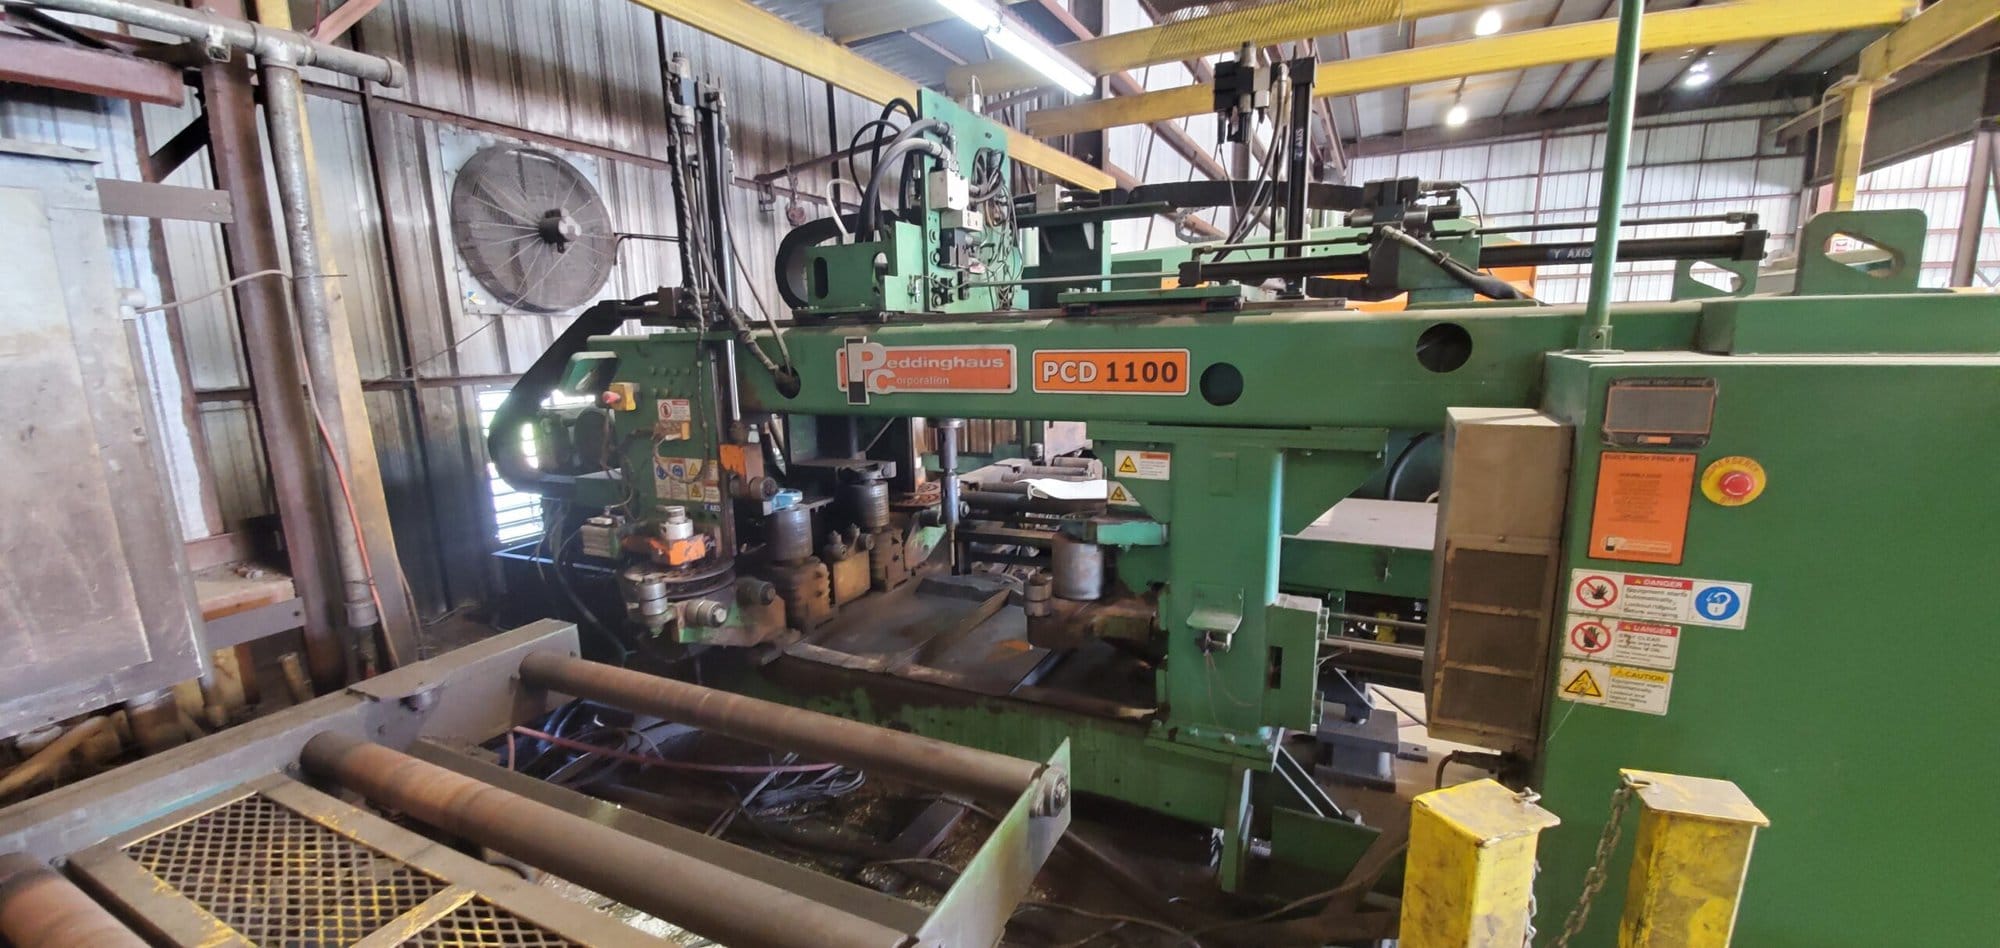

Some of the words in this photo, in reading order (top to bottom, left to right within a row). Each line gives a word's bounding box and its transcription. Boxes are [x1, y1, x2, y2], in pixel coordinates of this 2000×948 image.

[1551, 248, 1562, 259] Y
[1567, 247, 1592, 259] AXIS
[847, 342, 1005, 383] Peddinghaus
[1042, 361, 1098, 383] PCD
[1106, 361, 1178, 384] 1100
[868, 368, 949, 394] Corporation
[1643, 579, 1684, 589] DANGER
[1626, 586, 1666, 596] Equipment
[1633, 625, 1672, 635] DANGER
[1625, 671, 1665, 681] CAUTION
